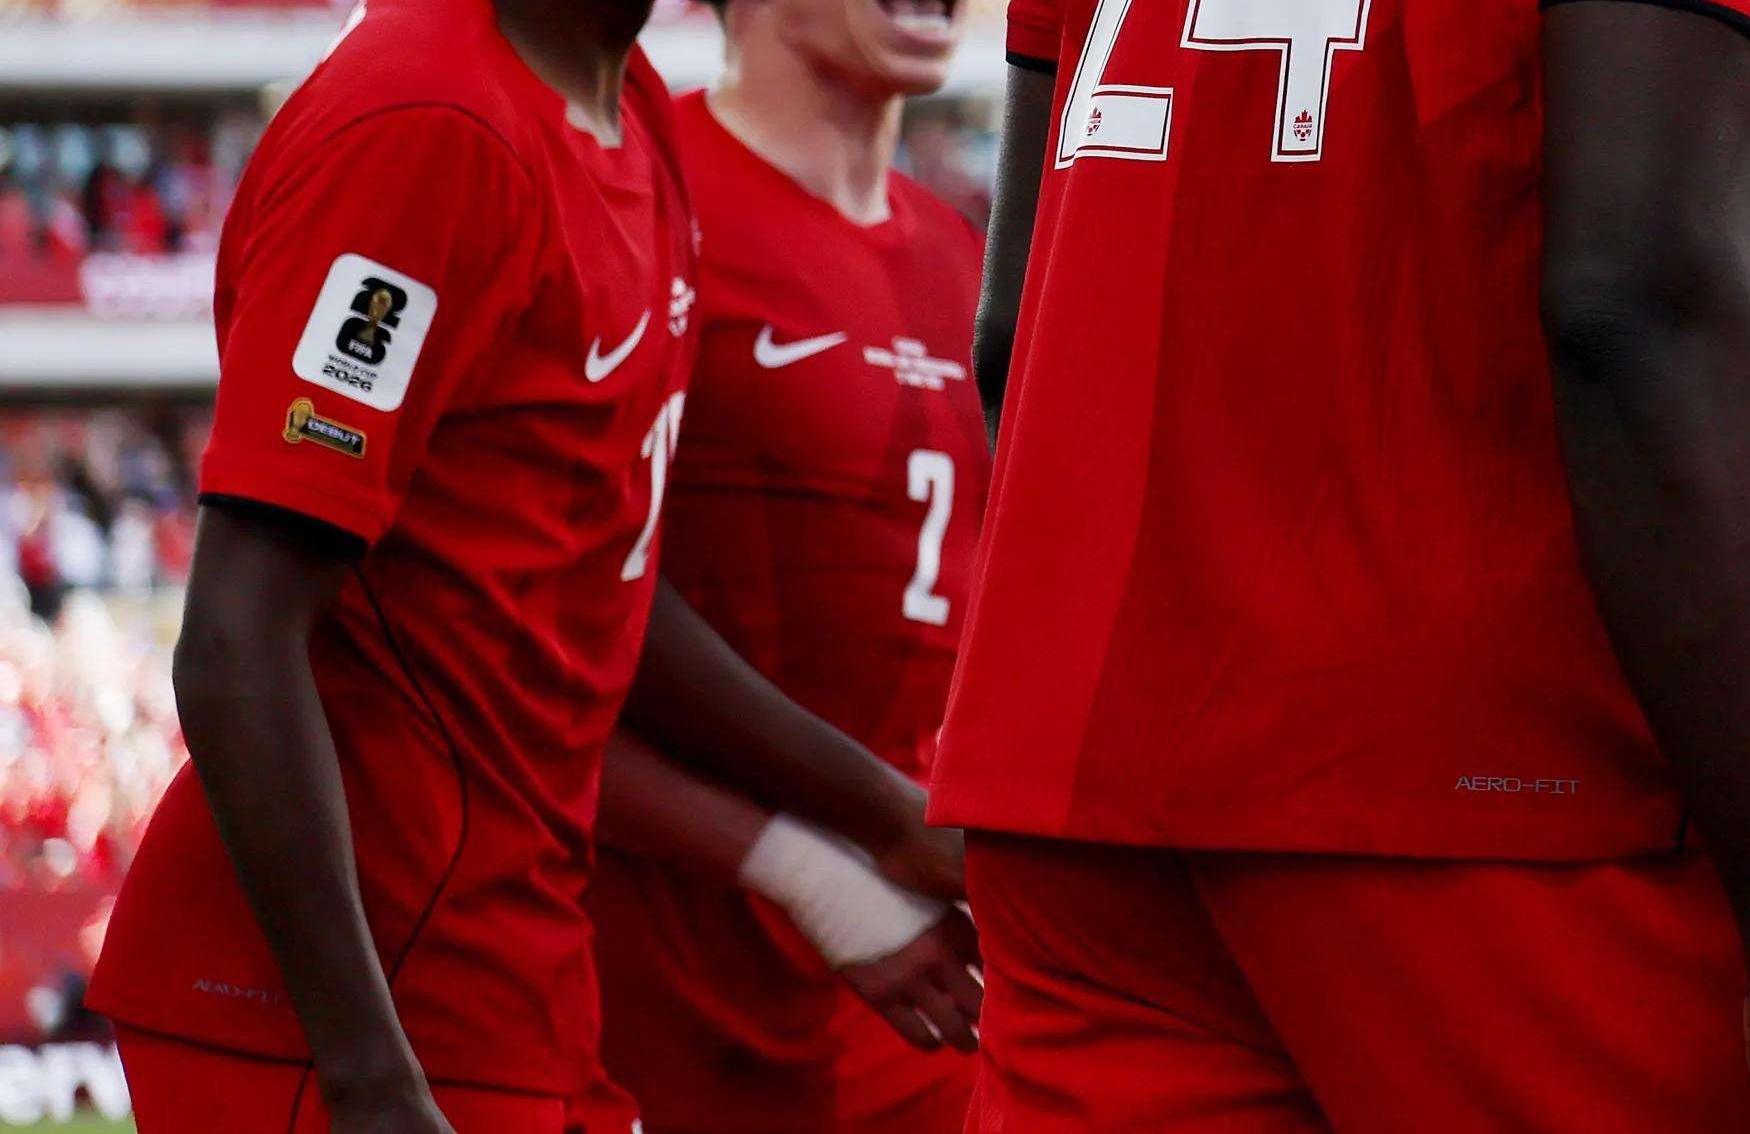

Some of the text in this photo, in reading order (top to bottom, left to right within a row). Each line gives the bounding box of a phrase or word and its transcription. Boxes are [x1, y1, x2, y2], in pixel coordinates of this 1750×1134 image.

[348, 338, 373, 359] FIFA
[322, 364, 373, 392] 2026
[308, 417, 361, 445] DEBUT
[903, 449, 954, 625] 2
[1455, 776, 1581, 794] AERO-FIT
